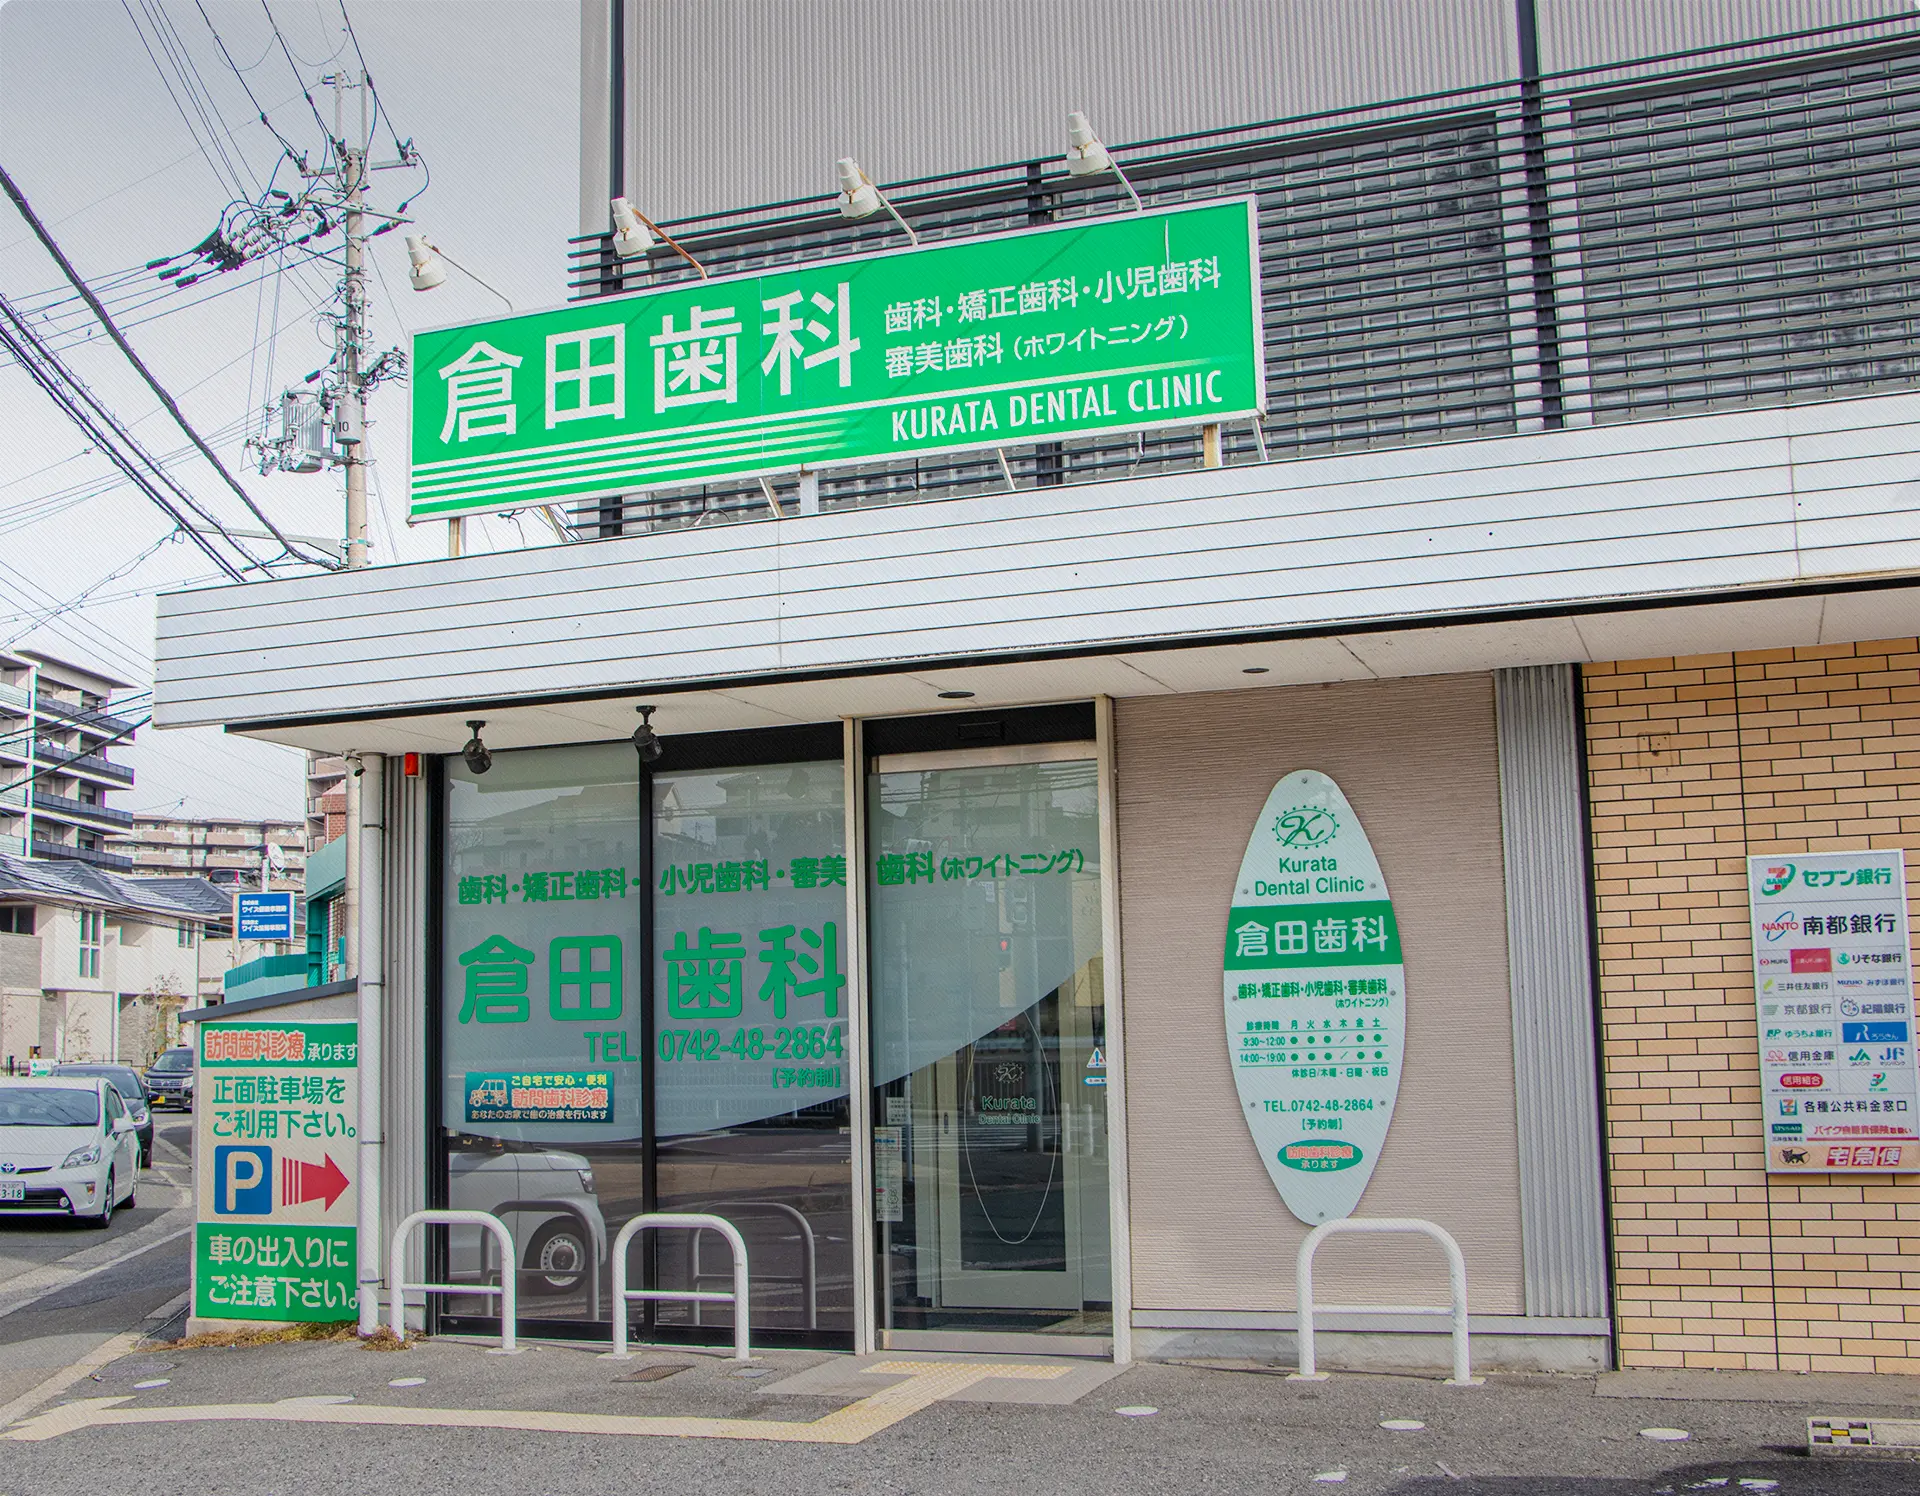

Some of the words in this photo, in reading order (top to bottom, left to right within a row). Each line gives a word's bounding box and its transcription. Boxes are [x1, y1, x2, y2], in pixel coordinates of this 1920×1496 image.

[884, 256, 1221, 335] 歯科・矯正歯科・小児歯科
[438, 282, 861, 444] 倉田歯科
[892, 399, 998, 442] KURATA
[1009, 384, 1116, 428] DENTAL
[1128, 370, 1223, 412] CLINIC
[1279, 856, 1337, 873] Kurata
[1255, 879, 1310, 896] Dental
[1315, 876, 1365, 893] Clinic
[1802, 868, 1892, 887] セブン銀行
[1762, 922, 1798, 931] NANTO
[1803, 914, 1896, 935] 南都銀行
[1235, 915, 1388, 957] 倉田歯科
[1852, 953, 1902, 964] りそな銀行
[1238, 978, 1388, 999] 歯科・矯正歯科・小児歯科・審美歯科
[1778, 982, 1829, 991] 三井住友銀行
[1784, 1004, 1832, 1015] 京都銀行
[1290, 1020, 1298, 1030] 月
[1307, 1020, 1315, 1029] 火
[1323, 1019, 1331, 1028] 水
[1339, 1018, 1348, 1028] 木
[1356, 1018, 1364, 1028] 金
[1372, 1018, 1381, 1027] 土
[1785, 1029, 1833, 1038] ゆうちょ銀行
[204, 1029, 305, 1061] 訪問歯科診療
[308, 1043, 357, 1061] 承ります
[658, 1026, 843, 1062] 0742-48-2864
[1788, 1050, 1835, 1061] 信用金庫
[212, 1075, 345, 1105] 正面駐車場を
[511, 1087, 608, 1108] 訪問歯科診療
[982, 1095, 1036, 1110] Kurata
[1804, 1100, 1907, 1113] 各種公共料金窓口
[213, 1109, 356, 1139] ご利用下さい。
[979, 1113, 1011, 1124] Dental
[1012, 1113, 1041, 1124] Clinic
[1828, 1147, 1901, 1166] 宅急便
[209, 1234, 348, 1268] 車の出入りに
[209, 1274, 357, 1310] ご注意下さい。
